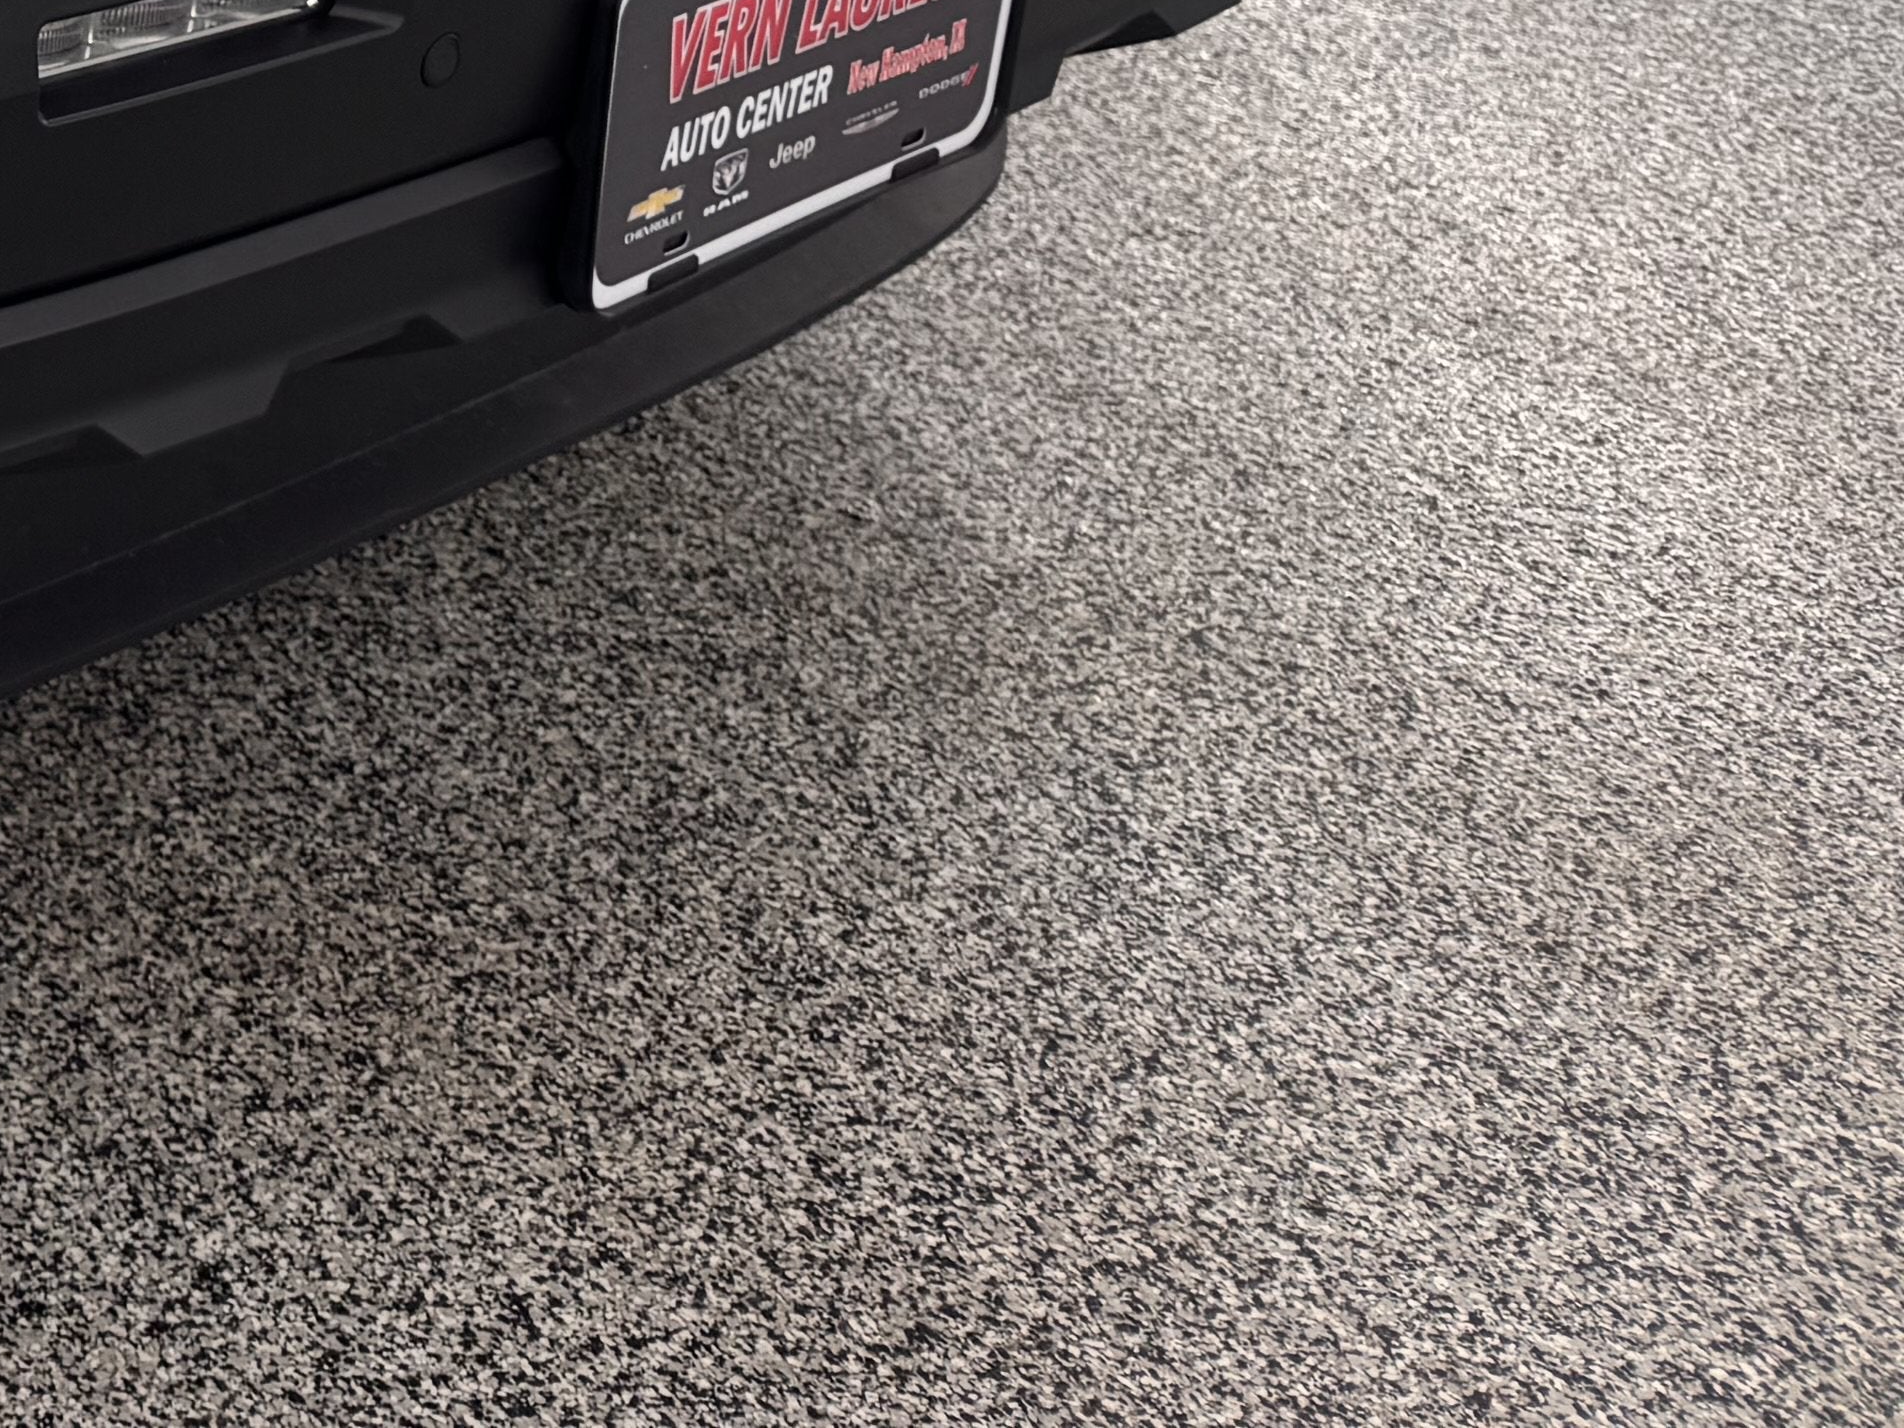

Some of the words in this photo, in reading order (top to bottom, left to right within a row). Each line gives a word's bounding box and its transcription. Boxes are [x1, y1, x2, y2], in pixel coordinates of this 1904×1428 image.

[847, 59, 880, 95] New
[660, 106, 731, 171] AUTO
[735, 65, 833, 139] CENTER
[769, 135, 816, 169] Jeep
[703, 190, 749, 217] RAM
[624, 210, 684, 245] CHEVROLET
